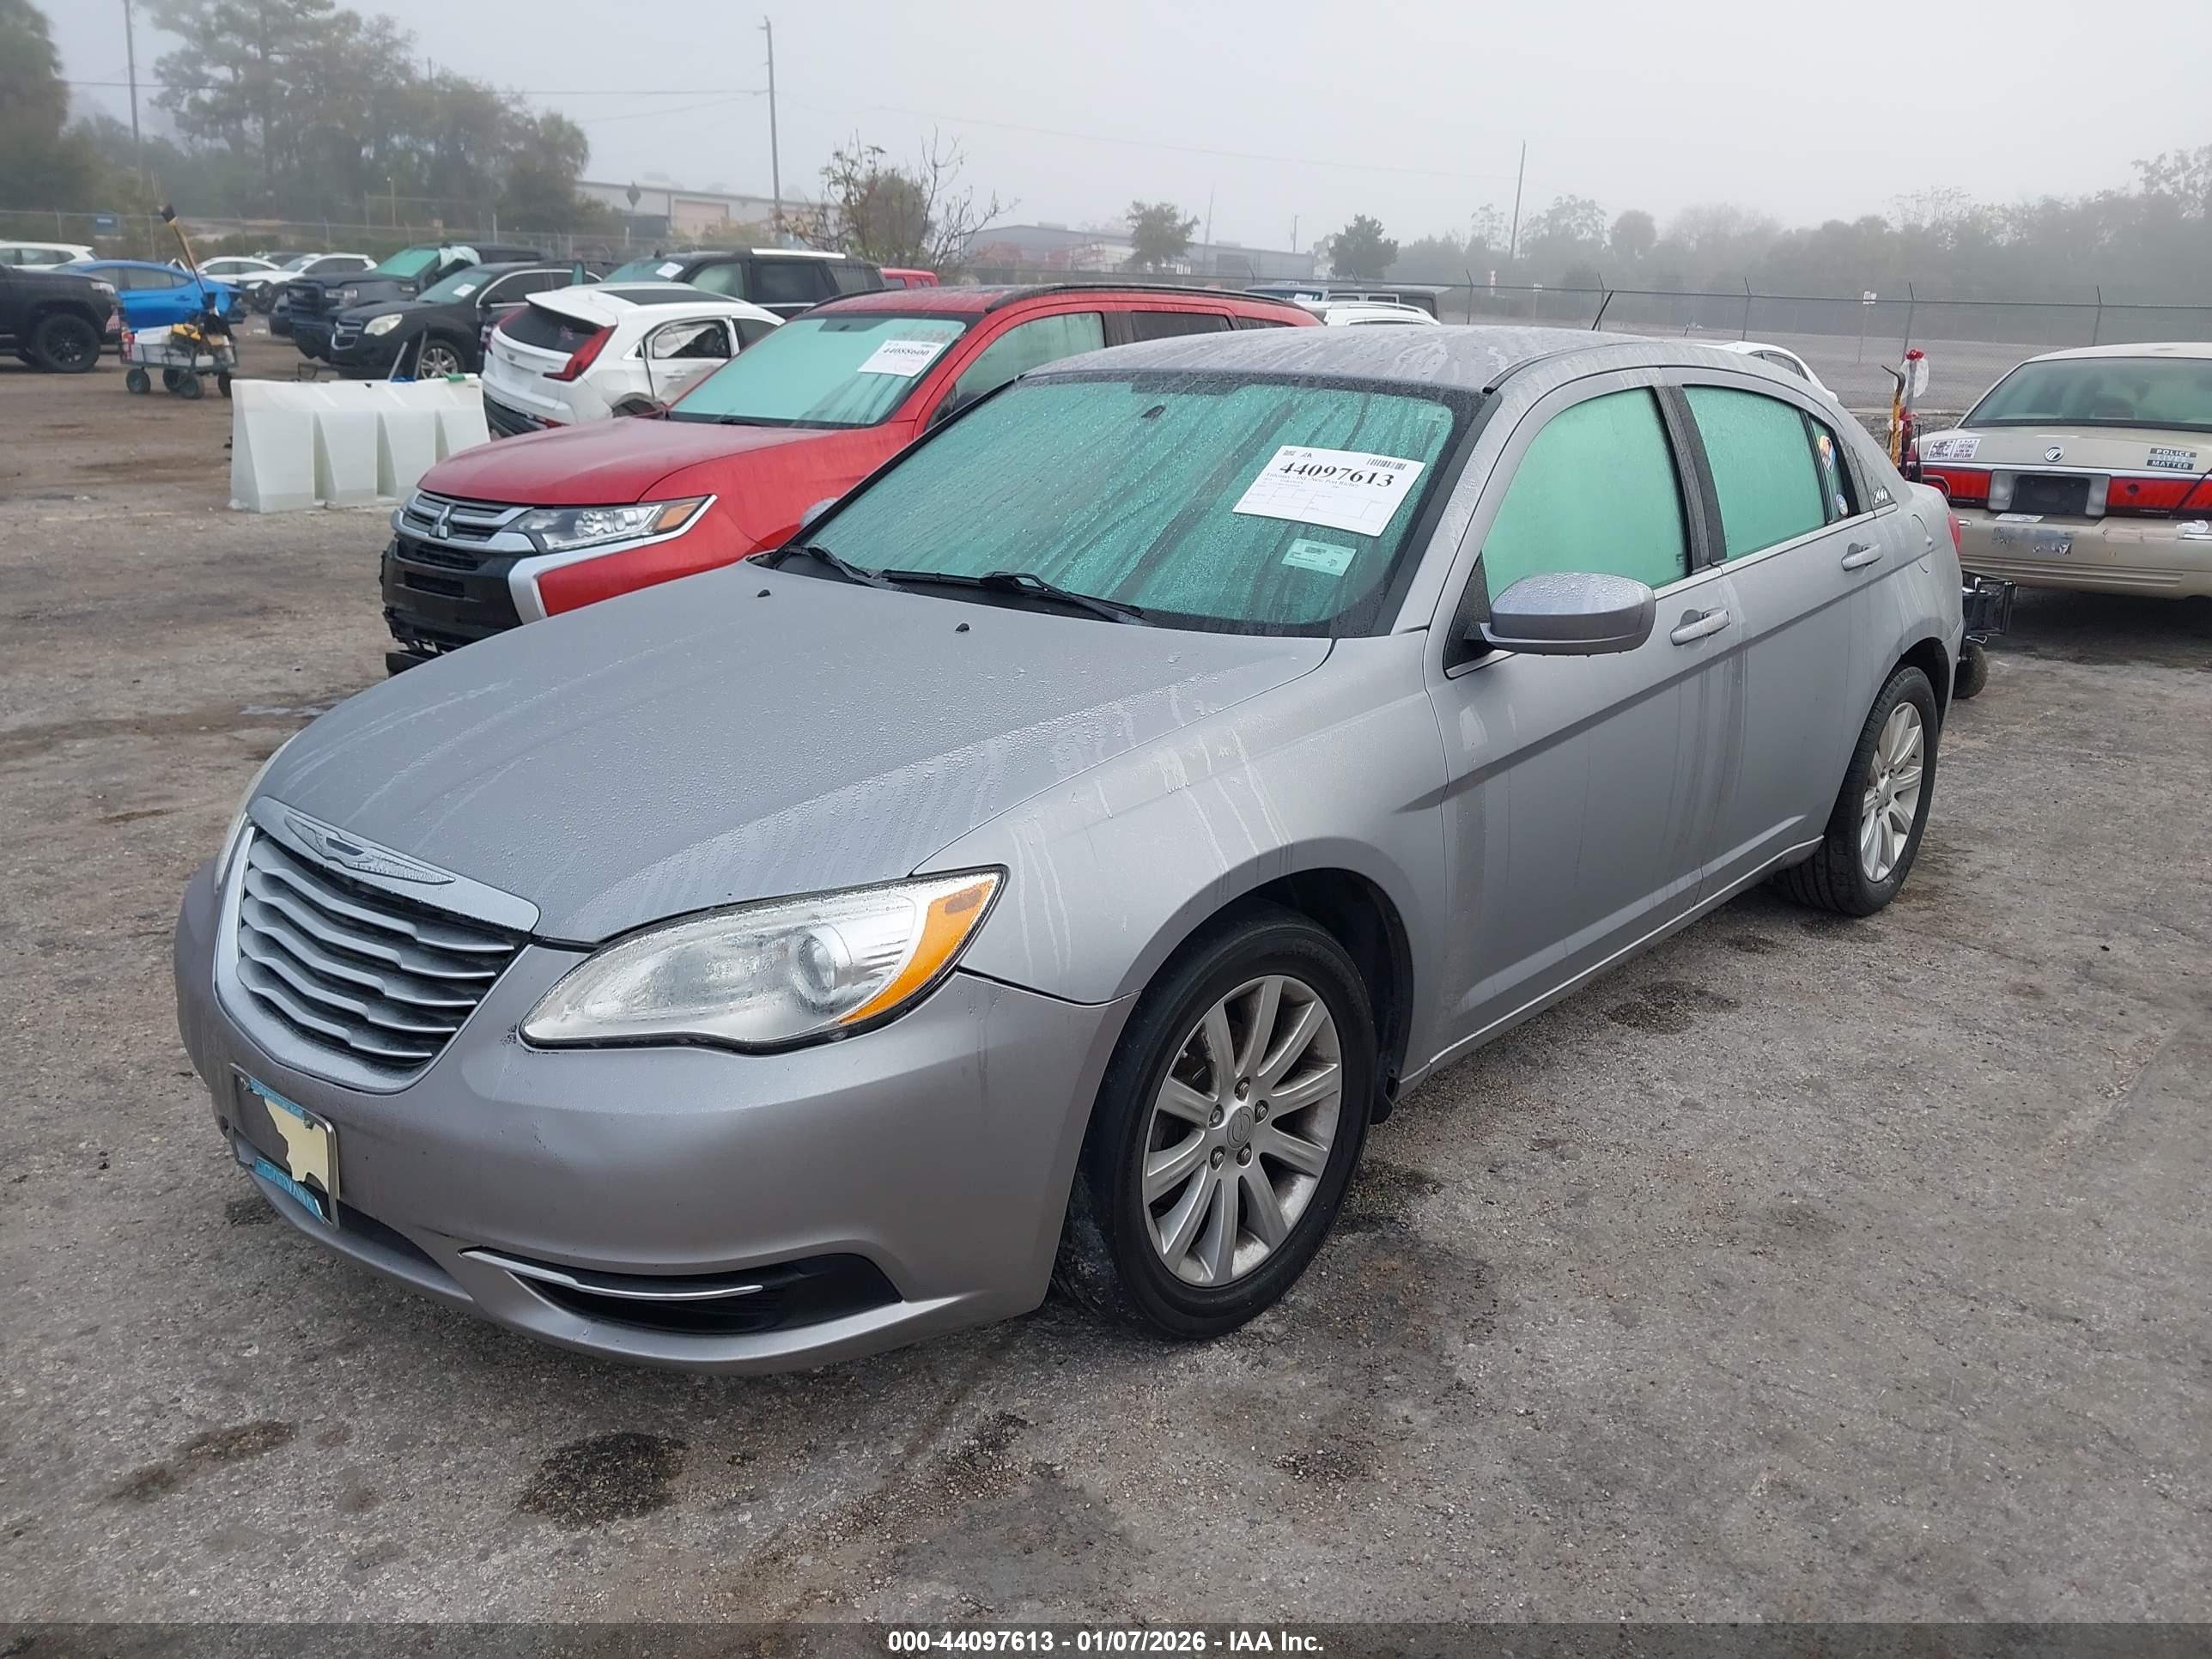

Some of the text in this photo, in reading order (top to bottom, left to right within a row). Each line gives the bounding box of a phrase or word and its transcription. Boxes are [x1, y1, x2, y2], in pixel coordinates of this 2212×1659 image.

[2156, 448, 2191, 457] POLICE
[2151, 460, 2190, 469] MATTER
[1279, 461, 1395, 488] 44097613
